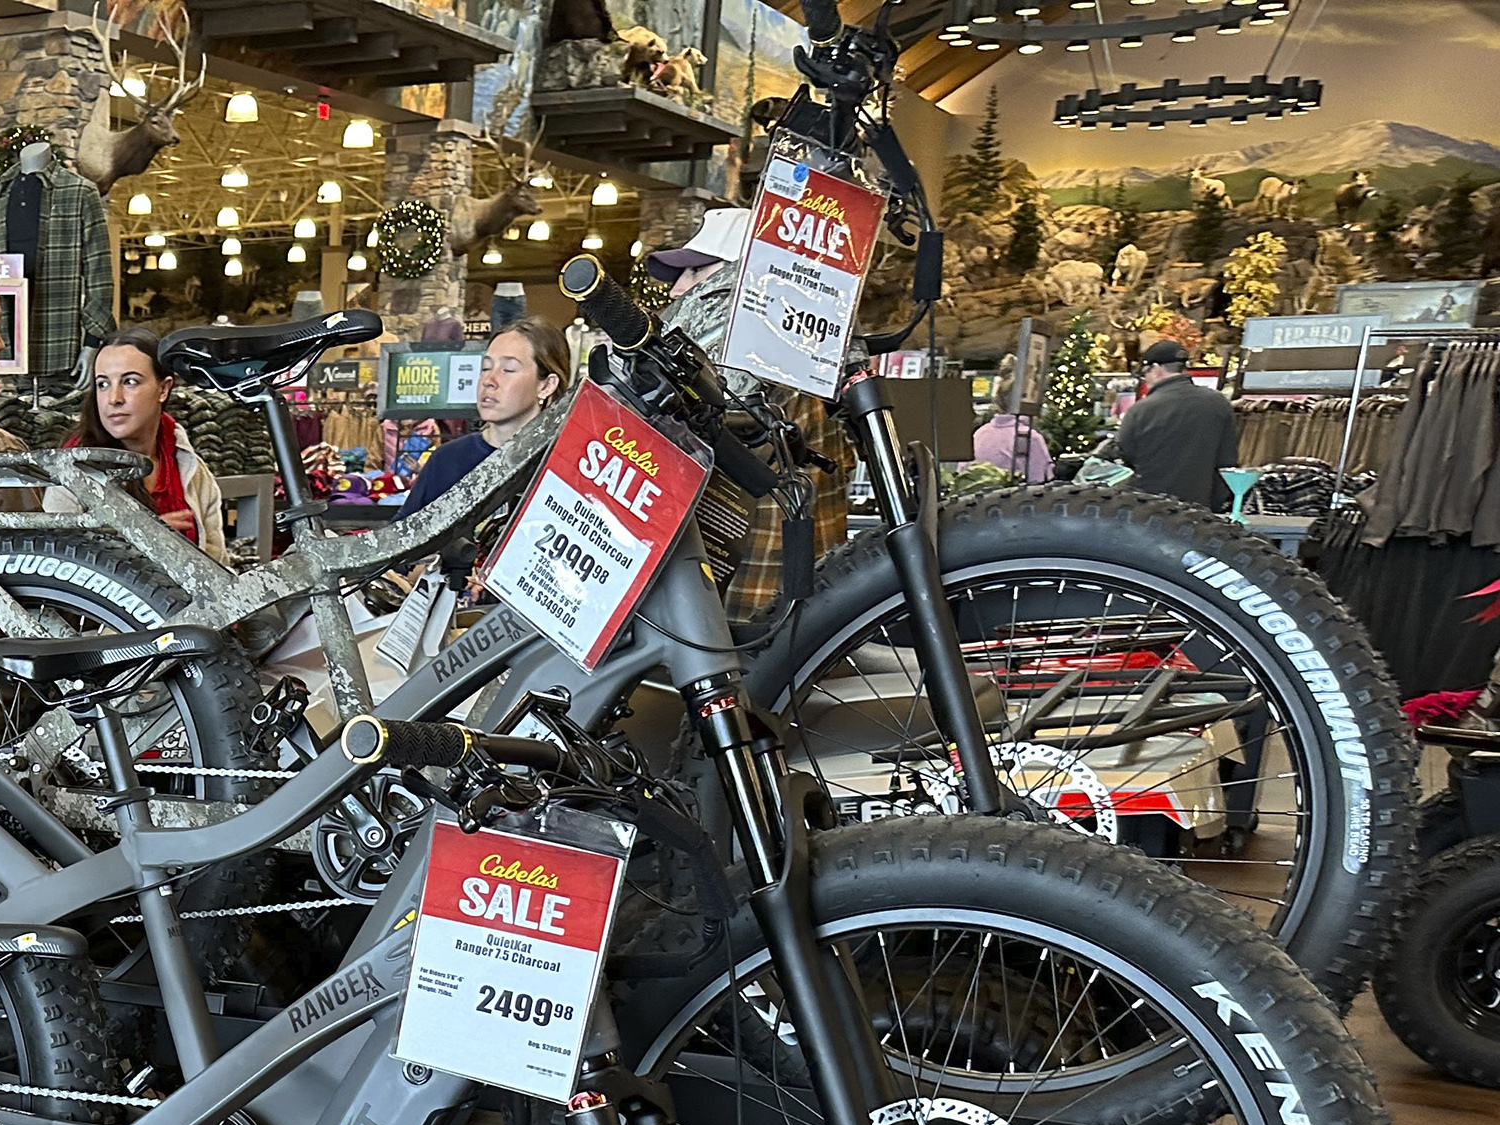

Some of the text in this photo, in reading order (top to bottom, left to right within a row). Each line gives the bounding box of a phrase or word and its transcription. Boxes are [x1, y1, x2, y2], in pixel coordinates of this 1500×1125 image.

[777, 207, 850, 261] SALE
[768, 264, 793, 280] Ranger
[1273, 327, 1307, 346] RED
[1310, 325, 1352, 343] HEAD
[396, 384, 440, 395] OUTDOORS
[397, 366, 440, 384] MORE
[603, 426, 660, 477] Cabela's
[578, 440, 662, 523] SALE
[545, 494, 633, 570] Ranger 10 Charcoal
[516, 575, 535, 598] Reg.
[535, 590, 576, 628] $3499.00
[431, 608, 527, 684] RANGER
[507, 628, 521, 643] 10
[1221, 577, 1373, 791] JUGGERNAUT
[479, 854, 559, 890] Cabela's
[458, 877, 571, 936] SALE
[455, 938, 561, 973] Ranger 7.5 Charcoal
[486, 933, 533, 954] QuietKat
[287, 960, 387, 1035] RANGER 7.5
